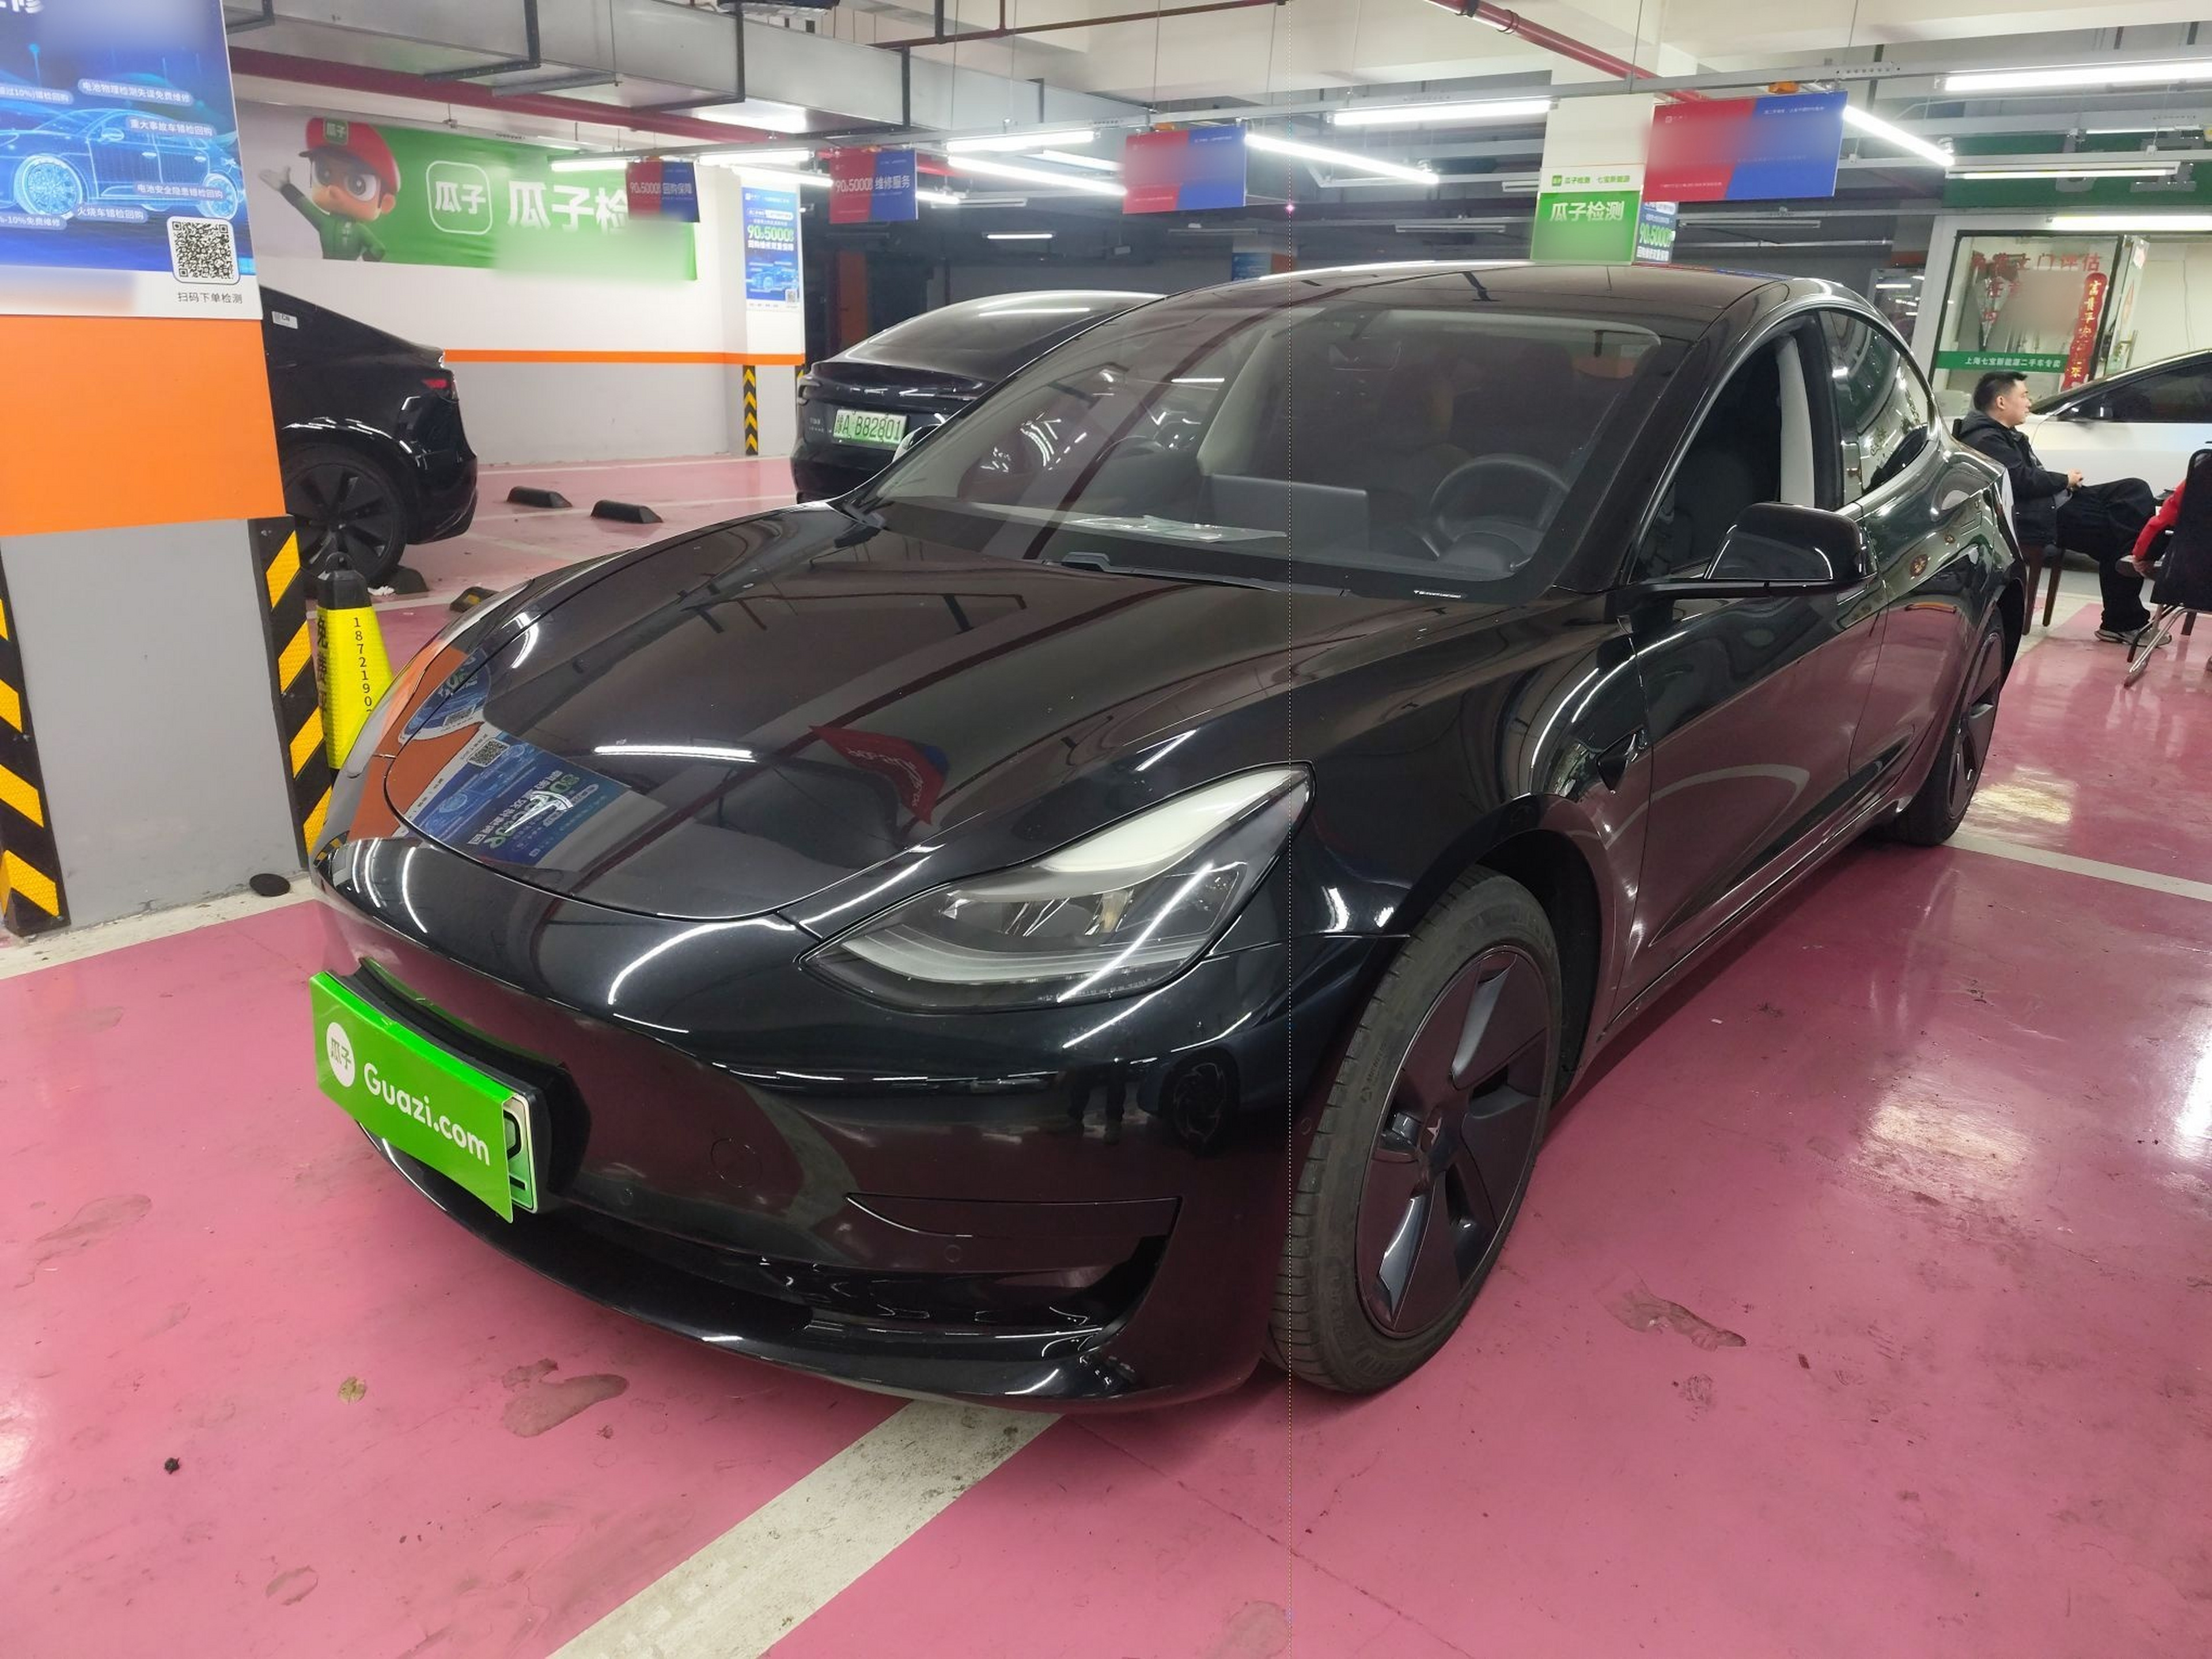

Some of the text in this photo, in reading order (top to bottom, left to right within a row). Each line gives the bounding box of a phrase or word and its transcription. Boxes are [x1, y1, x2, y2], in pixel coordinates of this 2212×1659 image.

[435, 181, 486, 215] 瓜子
[875, 175, 911, 190] 维修服务
[1550, 202, 1625, 222] 瓜子检测
[177, 292, 243, 304] 扫码下单检测
[353, 617, 373, 712] 1872190
[330, 1037, 352, 1070] 瓜子
[364, 1063, 490, 1166] Guazi.com
